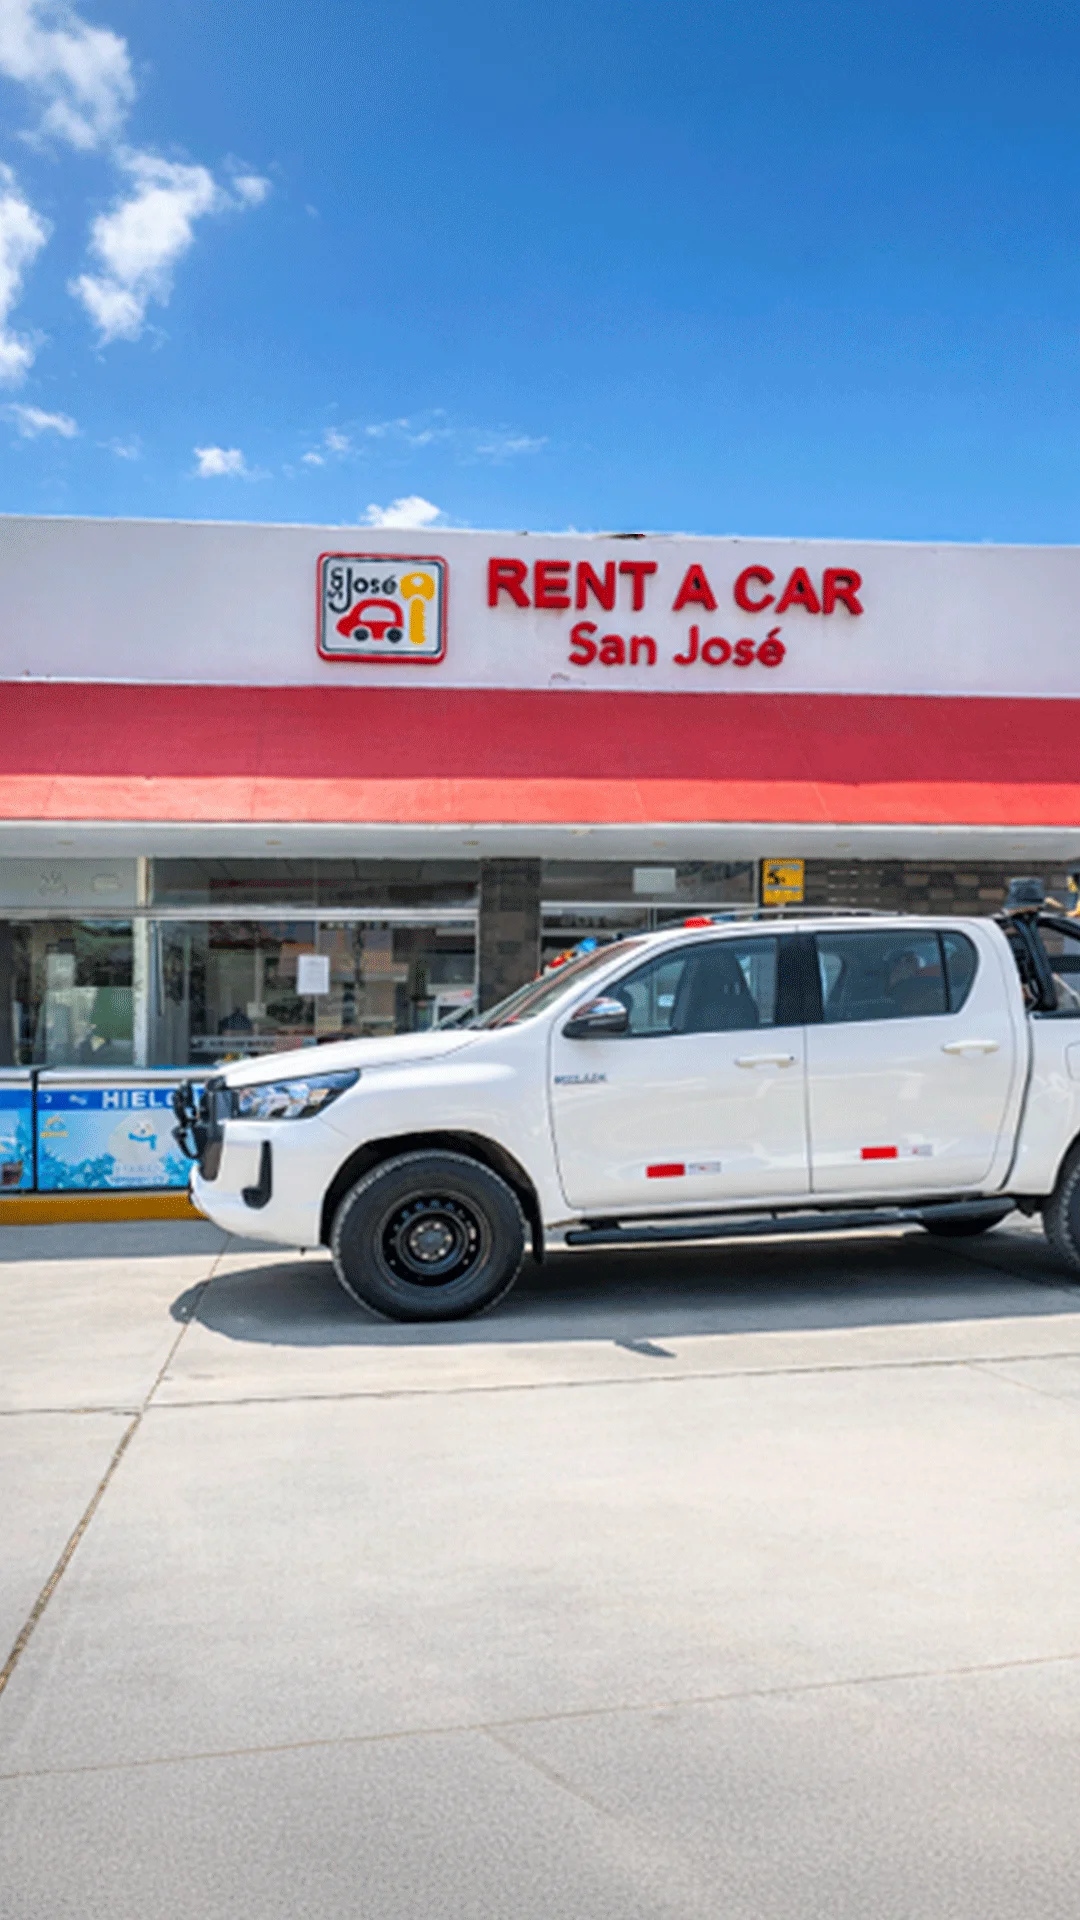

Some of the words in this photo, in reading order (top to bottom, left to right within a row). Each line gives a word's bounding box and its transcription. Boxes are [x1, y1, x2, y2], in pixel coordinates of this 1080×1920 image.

[487, 557, 658, 612] RENT
[672, 563, 718, 612] A
[733, 565, 864, 615] CAR
[568, 621, 657, 666] San
[673, 624, 786, 667] José
